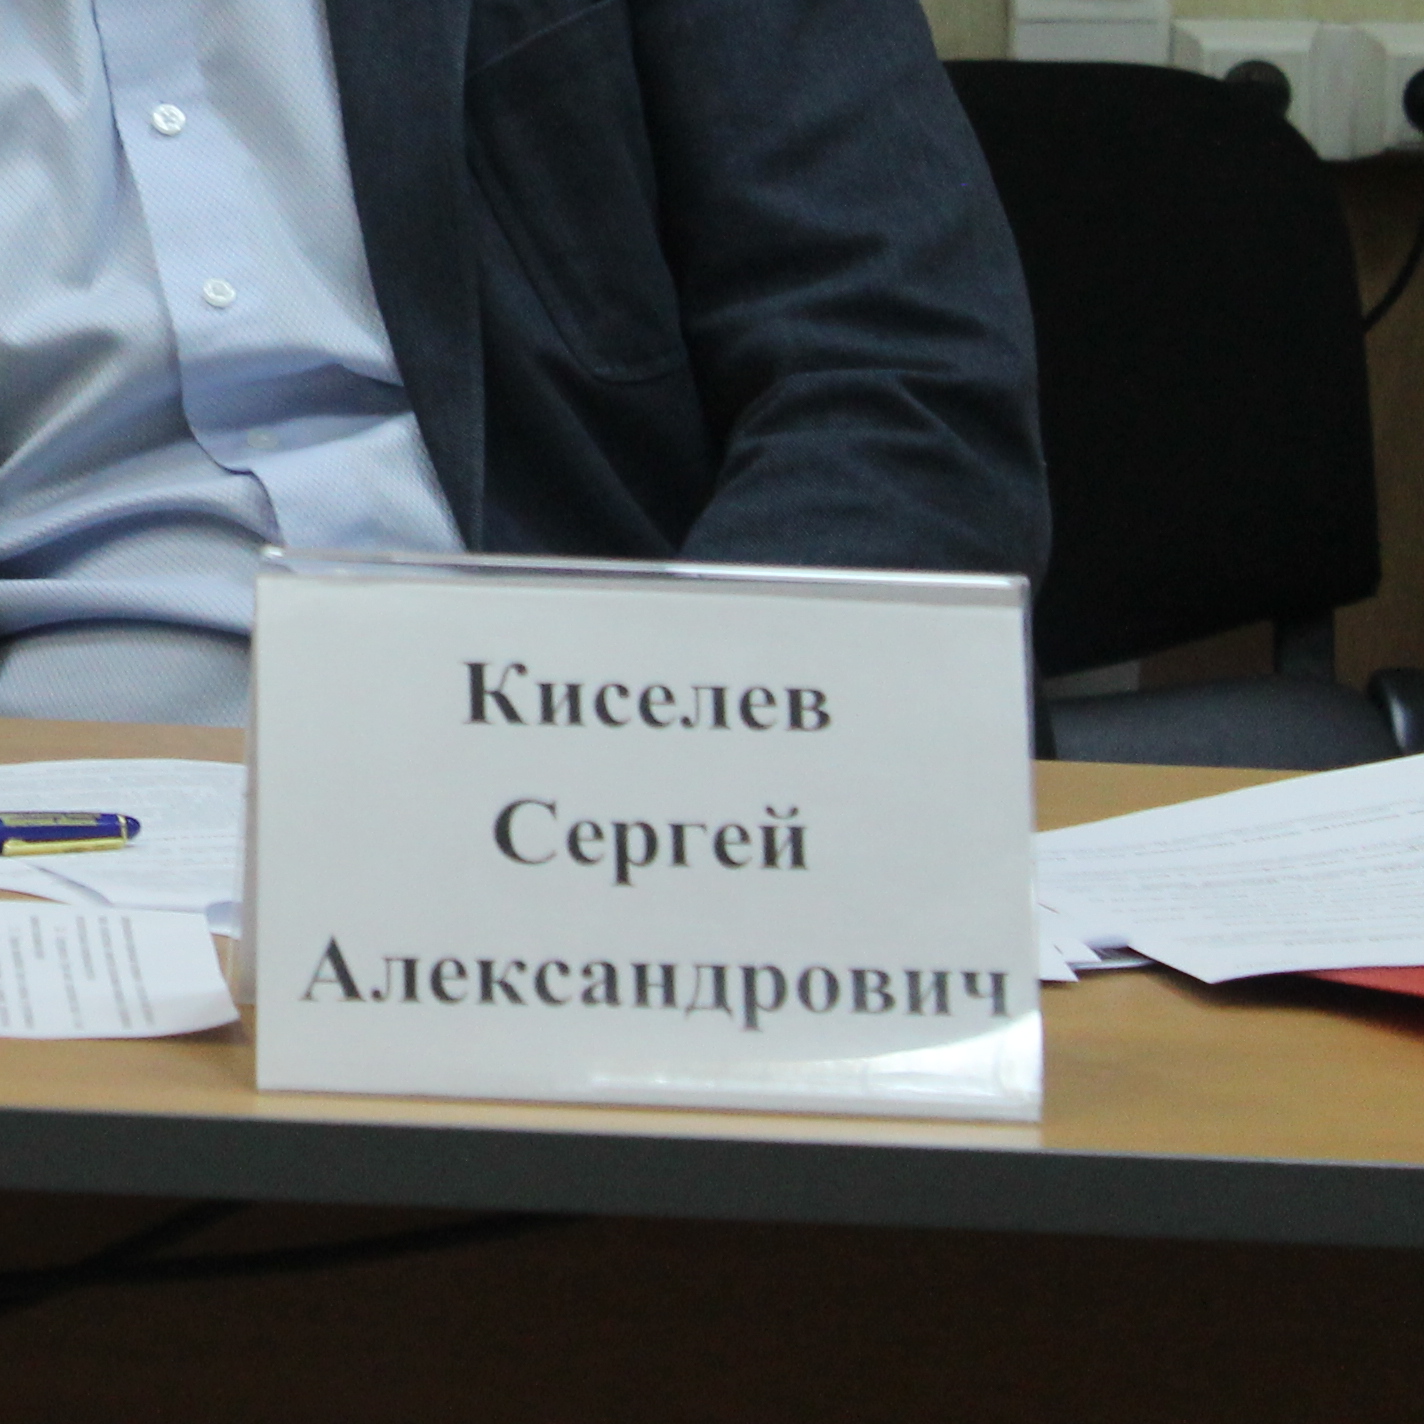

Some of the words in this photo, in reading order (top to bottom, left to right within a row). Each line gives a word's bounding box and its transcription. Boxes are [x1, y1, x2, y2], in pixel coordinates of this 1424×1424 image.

[462, 660, 833, 733] Киселев
[492, 798, 809, 887] Сергей
[301, 935, 1010, 1032] Александрович
